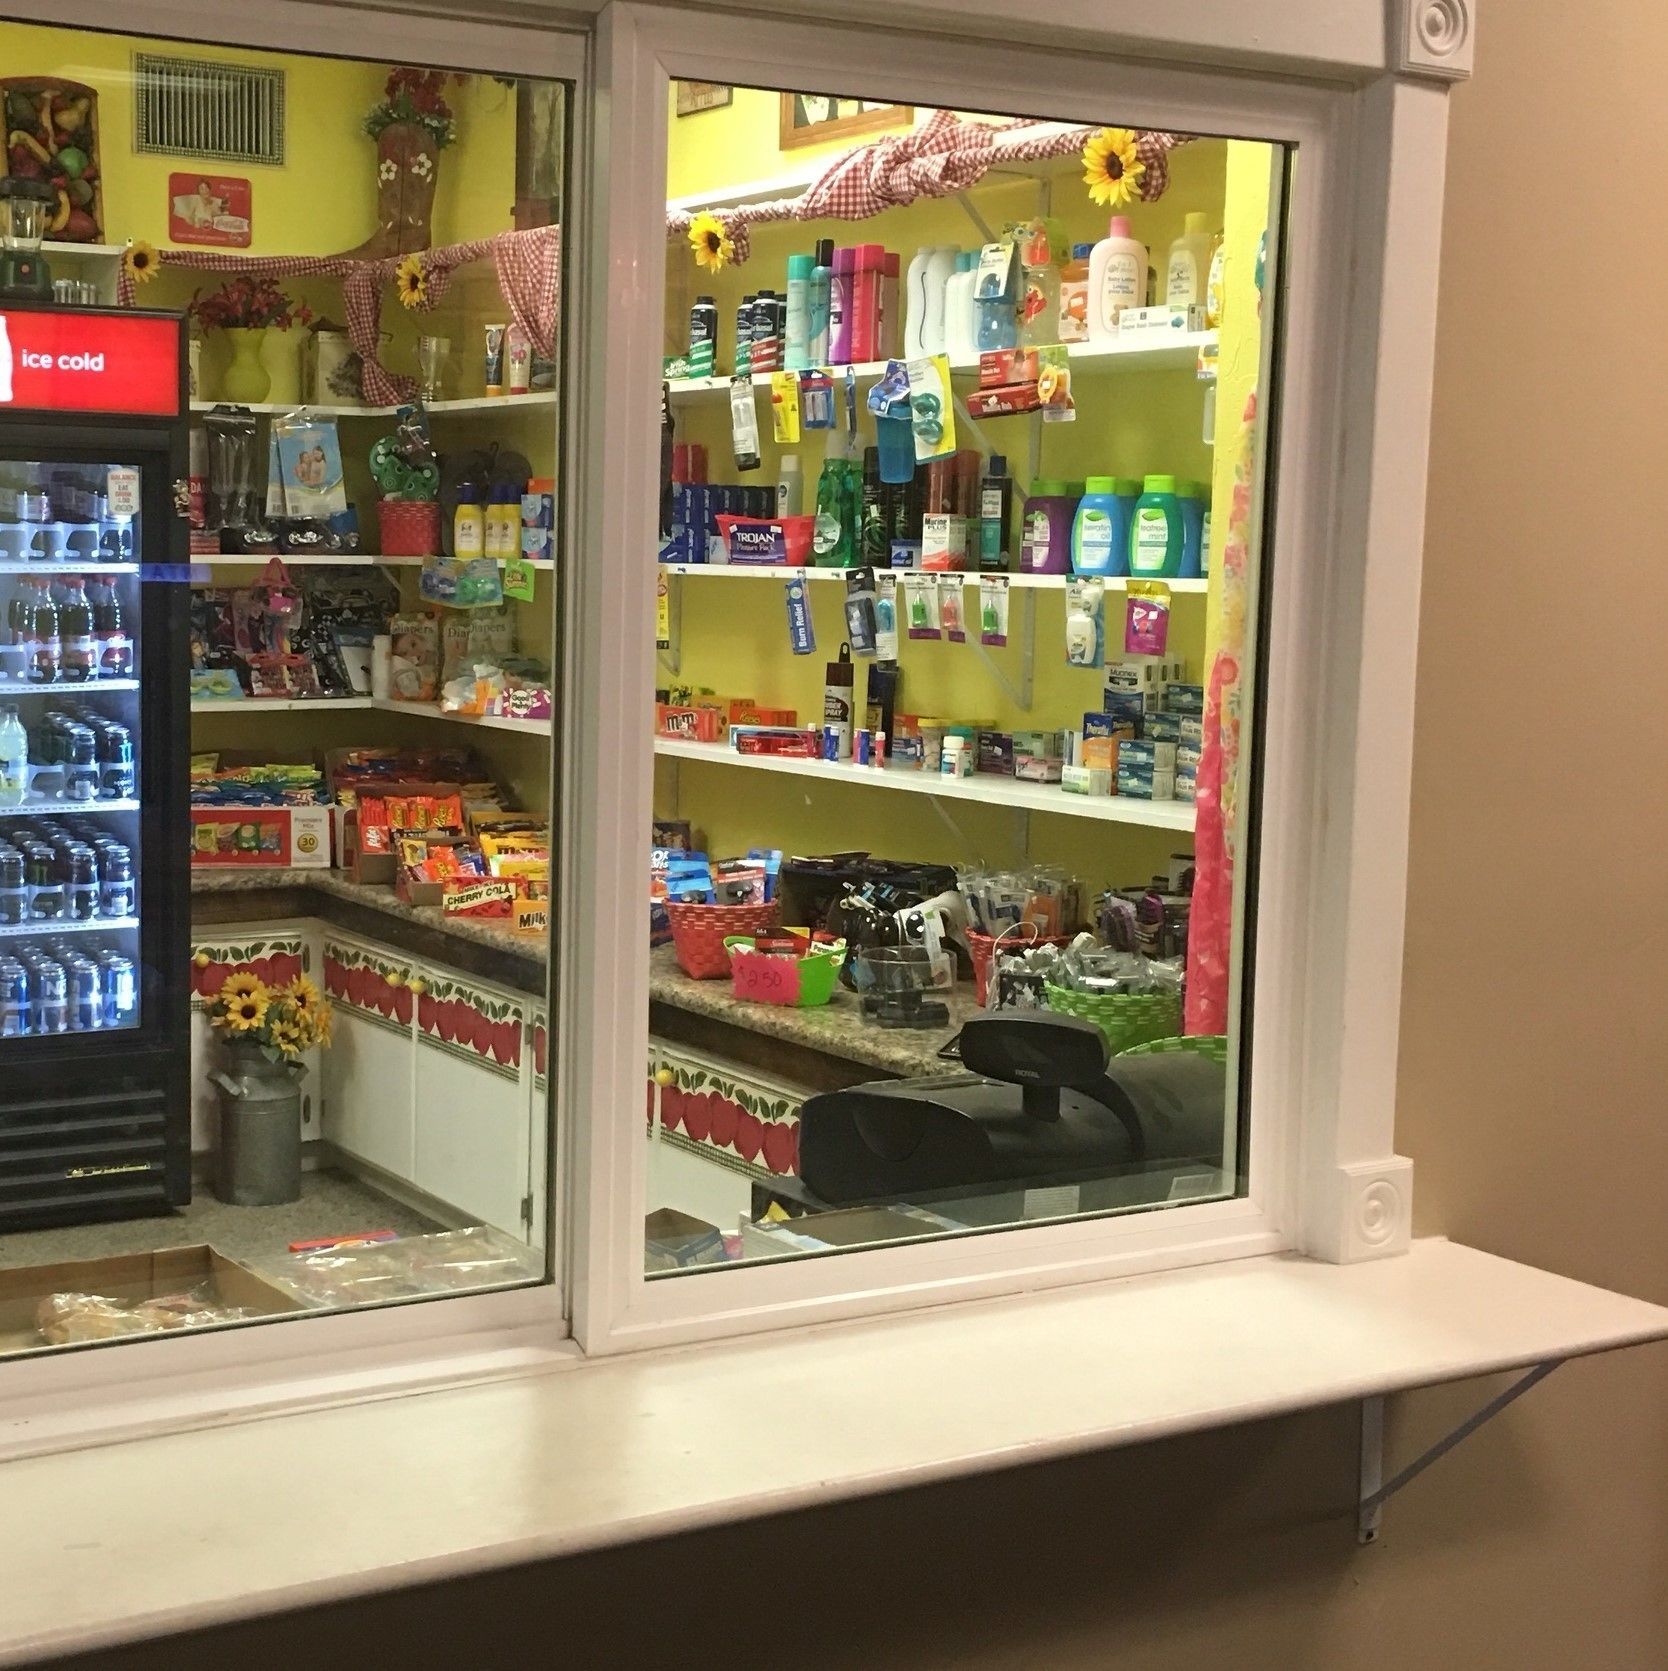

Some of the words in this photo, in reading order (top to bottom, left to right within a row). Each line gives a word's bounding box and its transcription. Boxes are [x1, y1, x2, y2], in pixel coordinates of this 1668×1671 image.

[21, 349, 53, 369] ice
[57, 352, 105, 372] cold
[736, 532, 776, 543] TROJAN
[793, 603, 804, 627] Relief
[798, 627, 808, 647] Burn
[1110, 668, 1137, 677] Mucinex
[302, 837, 315, 846] 30
[446, 890, 484, 906] CHERRY
[485, 883, 511, 898] COLA
[519, 911, 547, 929] Milk
